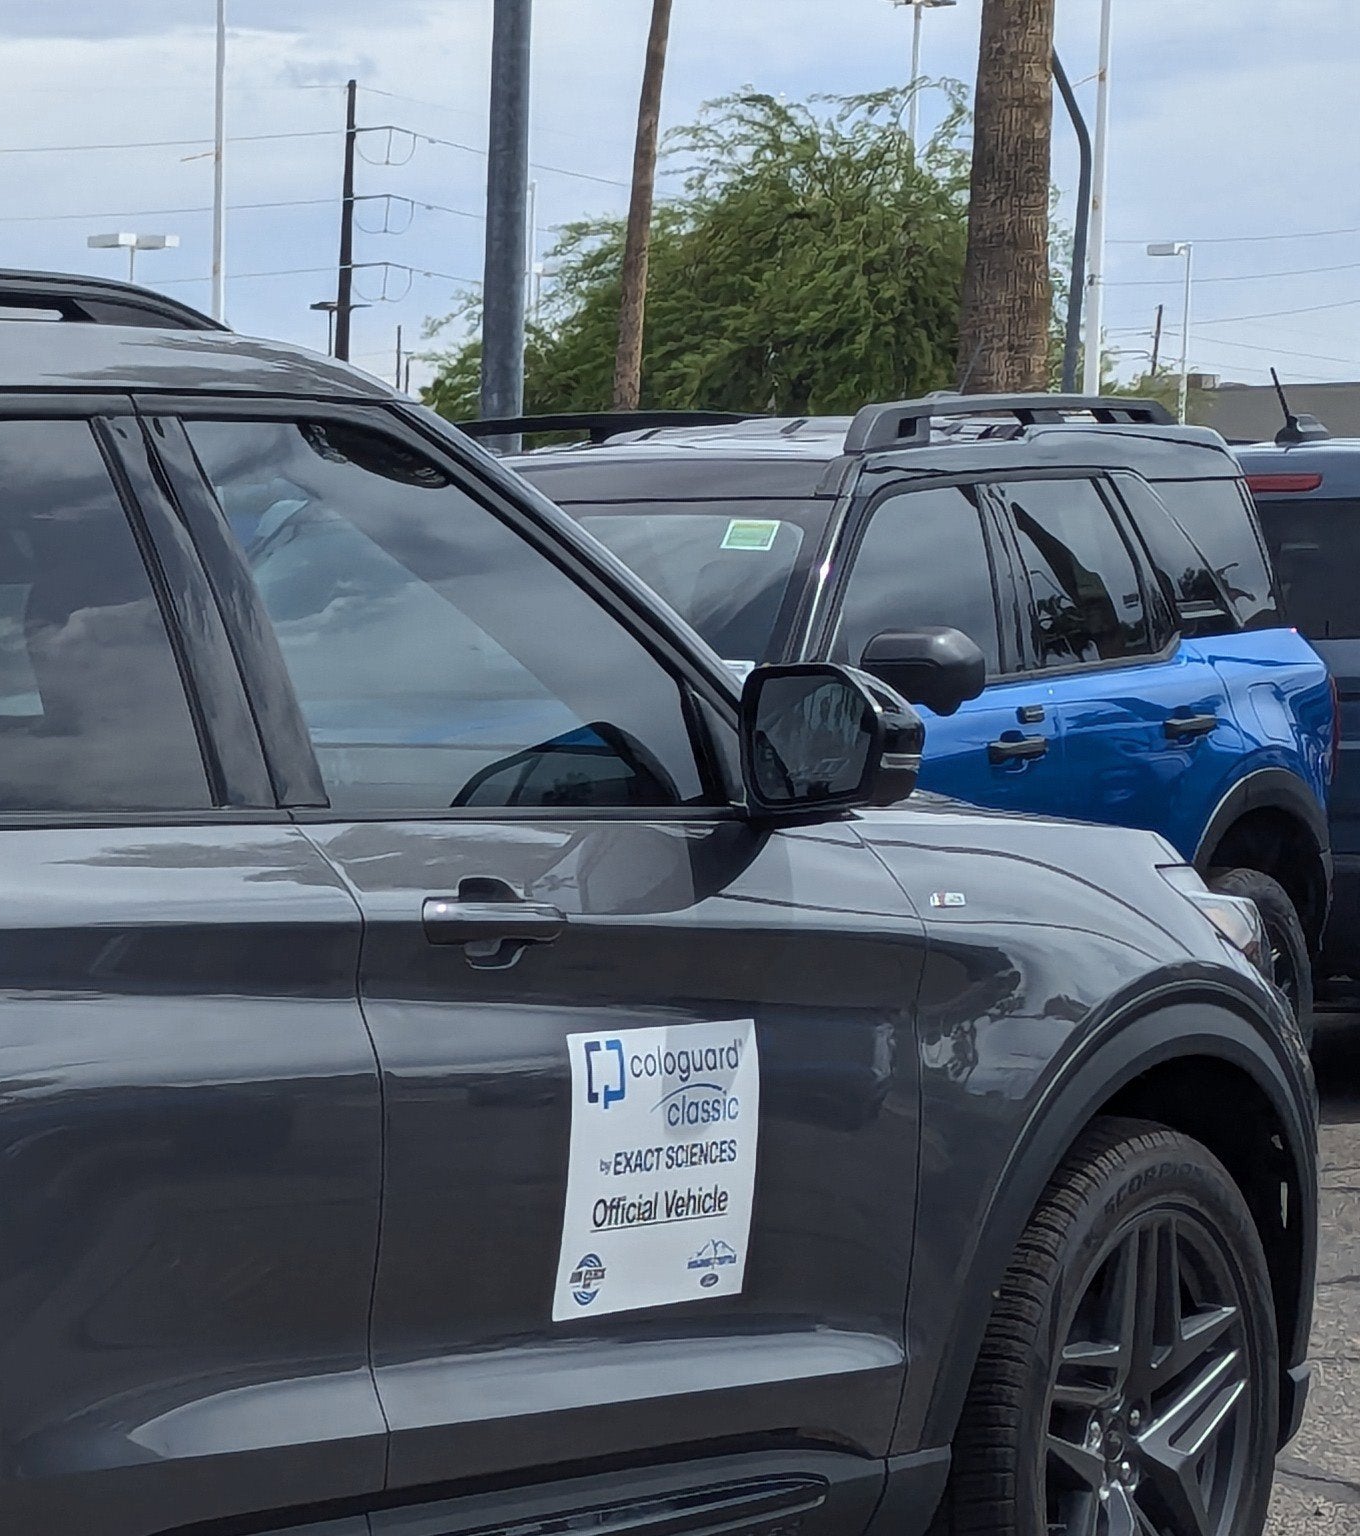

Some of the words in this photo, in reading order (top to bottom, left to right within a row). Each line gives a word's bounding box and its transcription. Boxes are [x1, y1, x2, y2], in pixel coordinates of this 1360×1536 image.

[630, 1039, 740, 1082] cologuard
[667, 1090, 739, 1127] classic
[613, 1146, 663, 1176] EXACT
[666, 1139, 737, 1171] SCIENCES
[592, 1191, 658, 1229] Official
[664, 1184, 729, 1218] Vehicle
